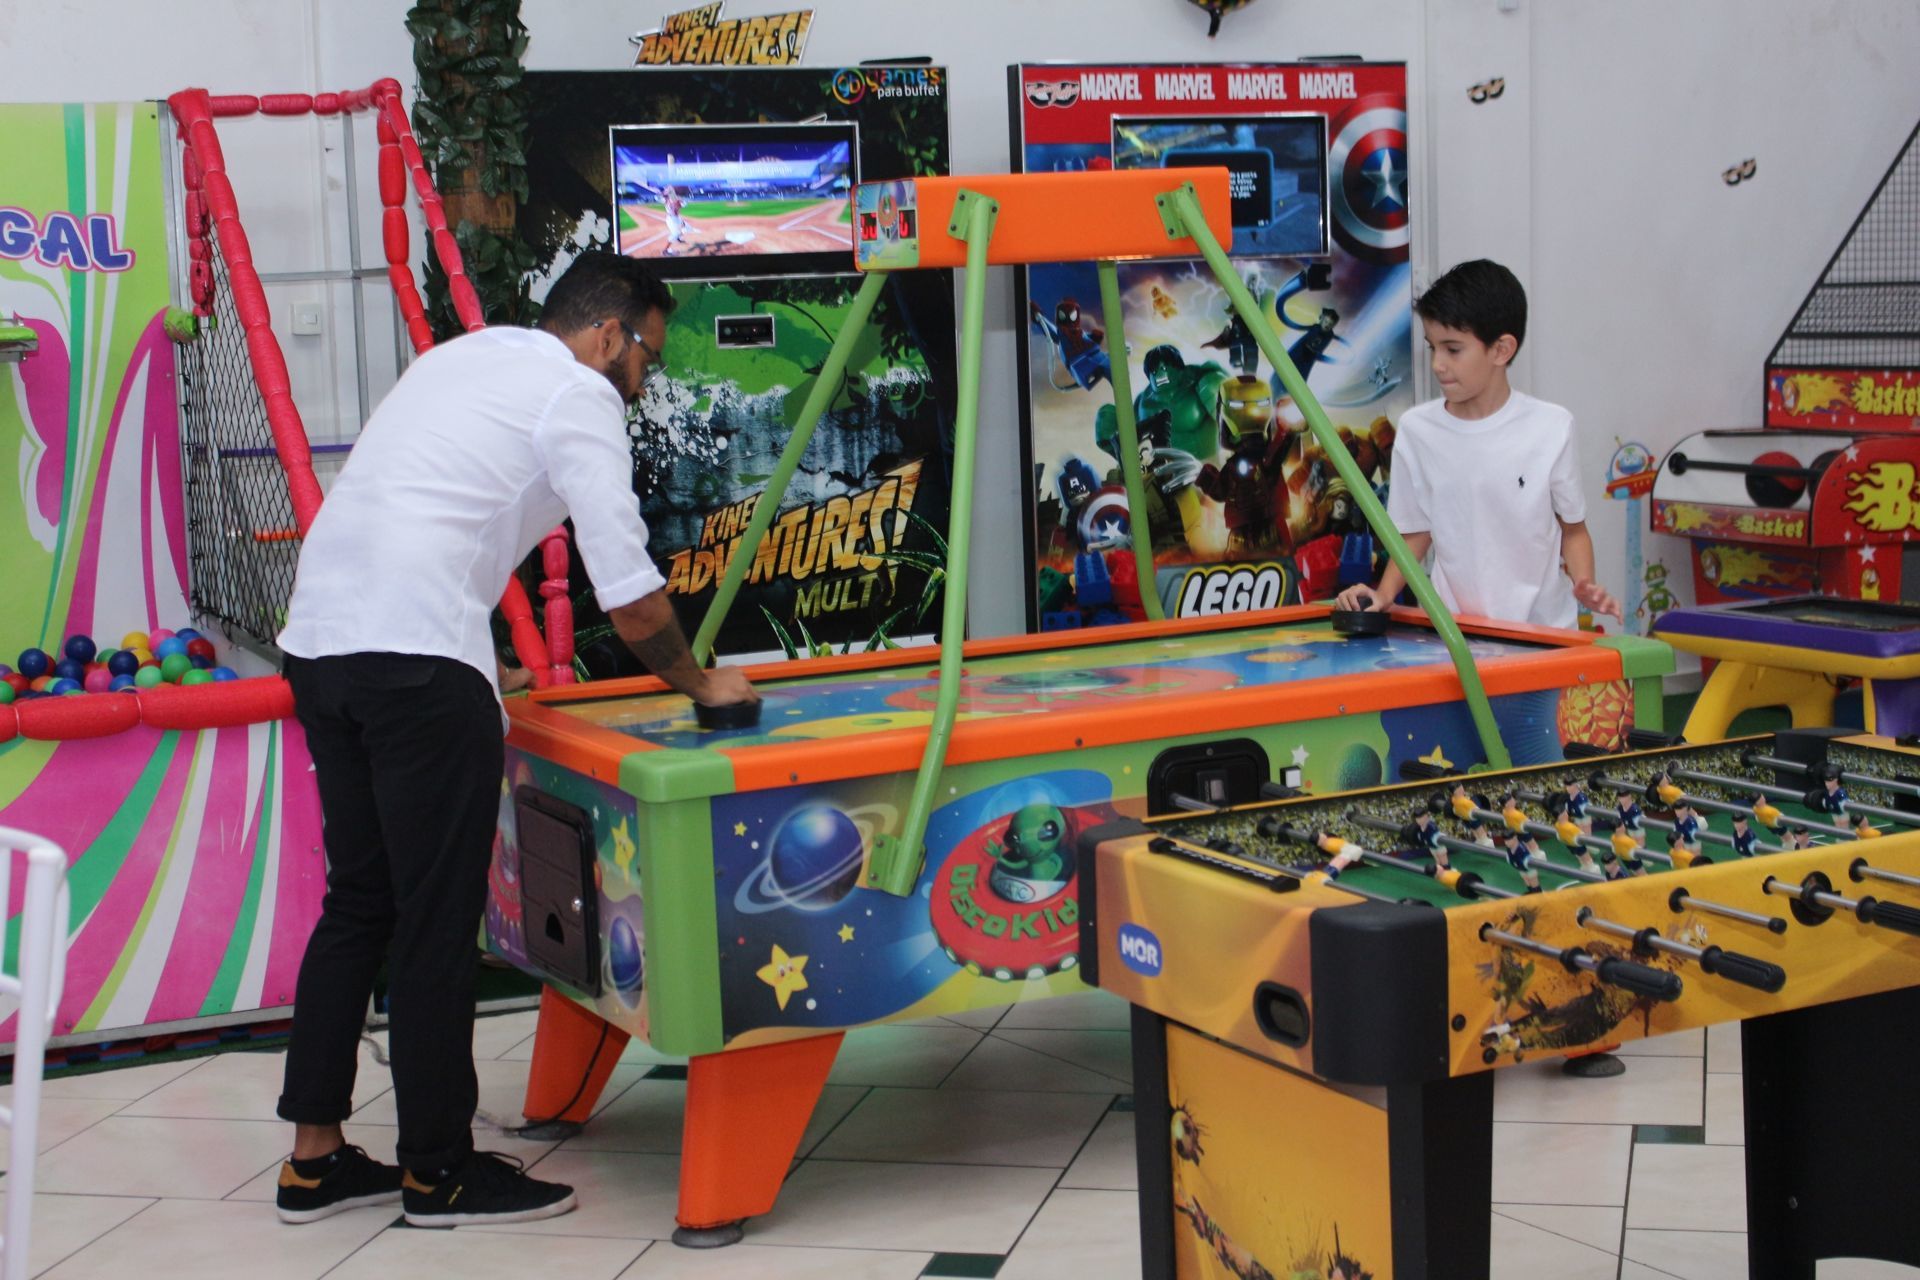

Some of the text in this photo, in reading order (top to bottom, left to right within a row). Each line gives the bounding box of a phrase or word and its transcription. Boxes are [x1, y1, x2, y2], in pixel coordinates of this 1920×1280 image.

[664, 2, 721, 34] KINECT
[638, 10, 814, 66] ADVENTURES!
[877, 84, 940, 100] para buffet
[1080, 72, 1357, 100] MARVEL MARVEL MARVEL MARVEL
[665, 459, 924, 595] ADVNTURES!
[701, 491, 764, 548] KINE
[1733, 514, 1804, 539] Basket
[1180, 568, 1281, 618] LEGO
[1120, 934, 1159, 968] MOR
